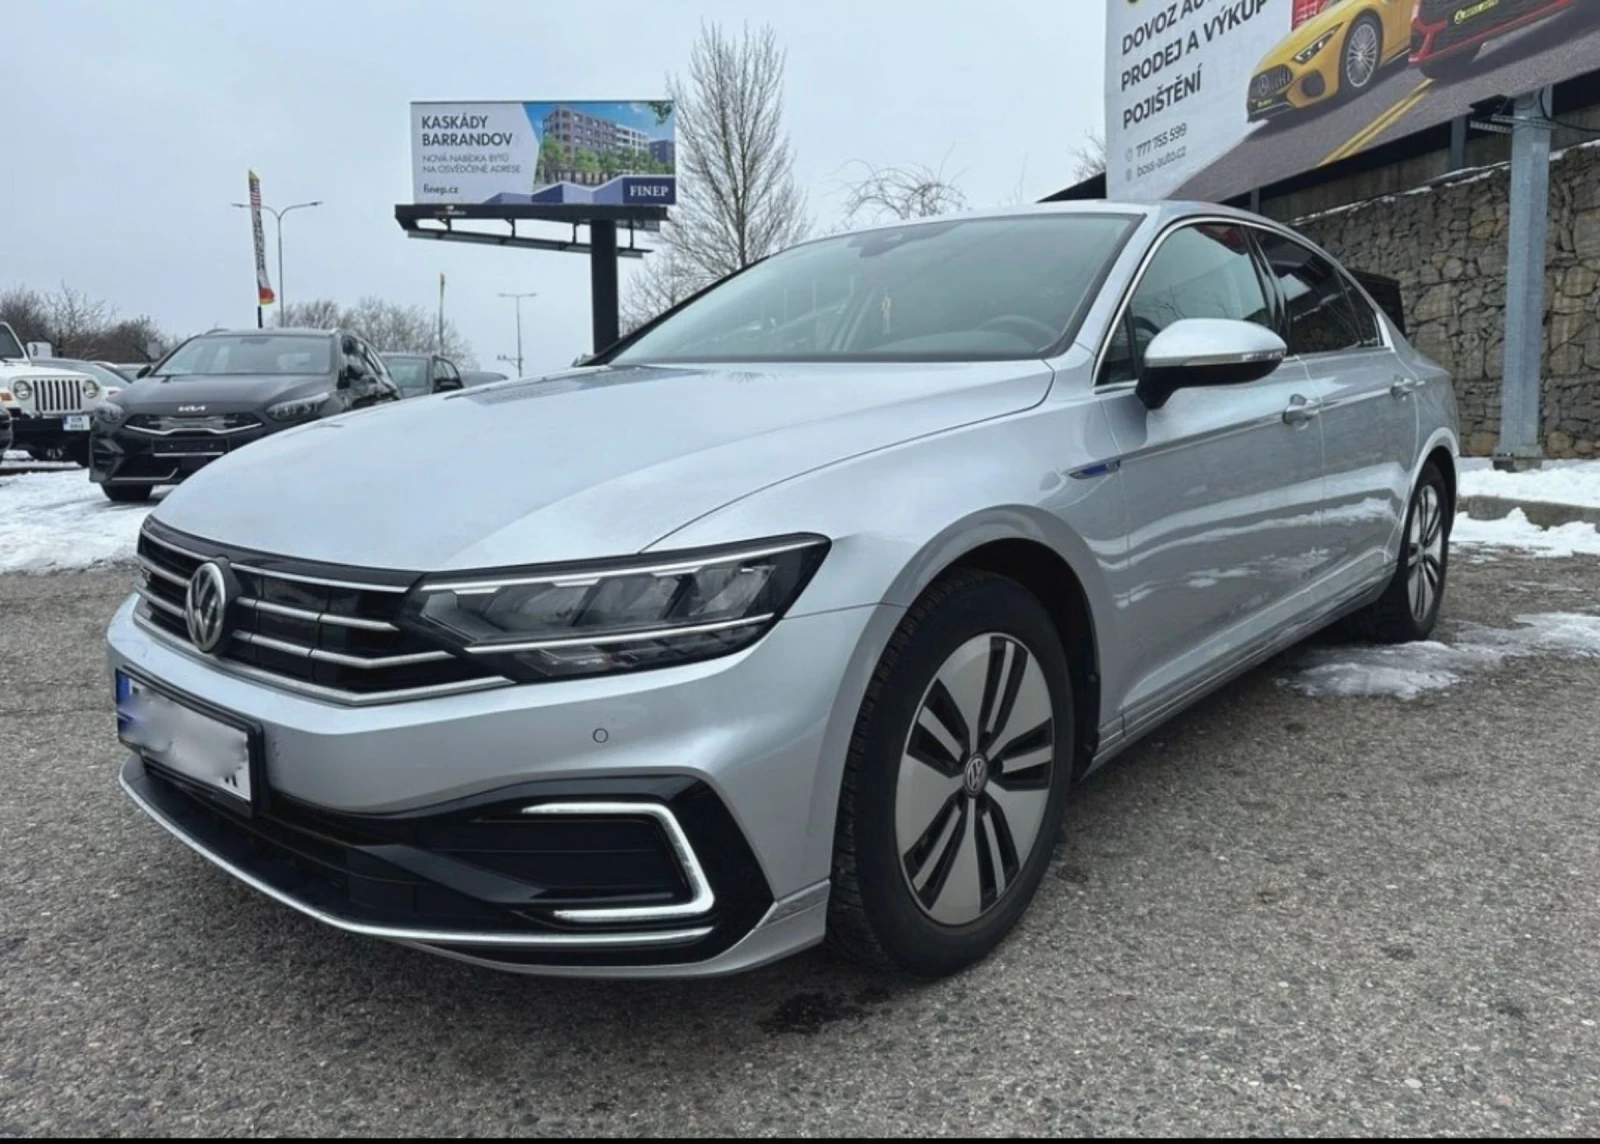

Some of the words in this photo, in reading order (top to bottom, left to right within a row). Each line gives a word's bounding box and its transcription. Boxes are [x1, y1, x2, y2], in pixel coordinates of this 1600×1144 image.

[1122, 3, 1177, 55] DOVOZ
[1121, 38, 1182, 92] PRODEJ
[1186, 30, 1199, 54] A
[1123, 62, 1202, 130] POJIŠTĚNÍ
[421, 112, 488, 129] KASKÁDY
[422, 132, 513, 146] BARRANDOV
[1136, 139, 1152, 158] 777
[1169, 122, 1187, 141] 599
[423, 183, 459, 195] finep.cz
[629, 185, 669, 197] FINEP
